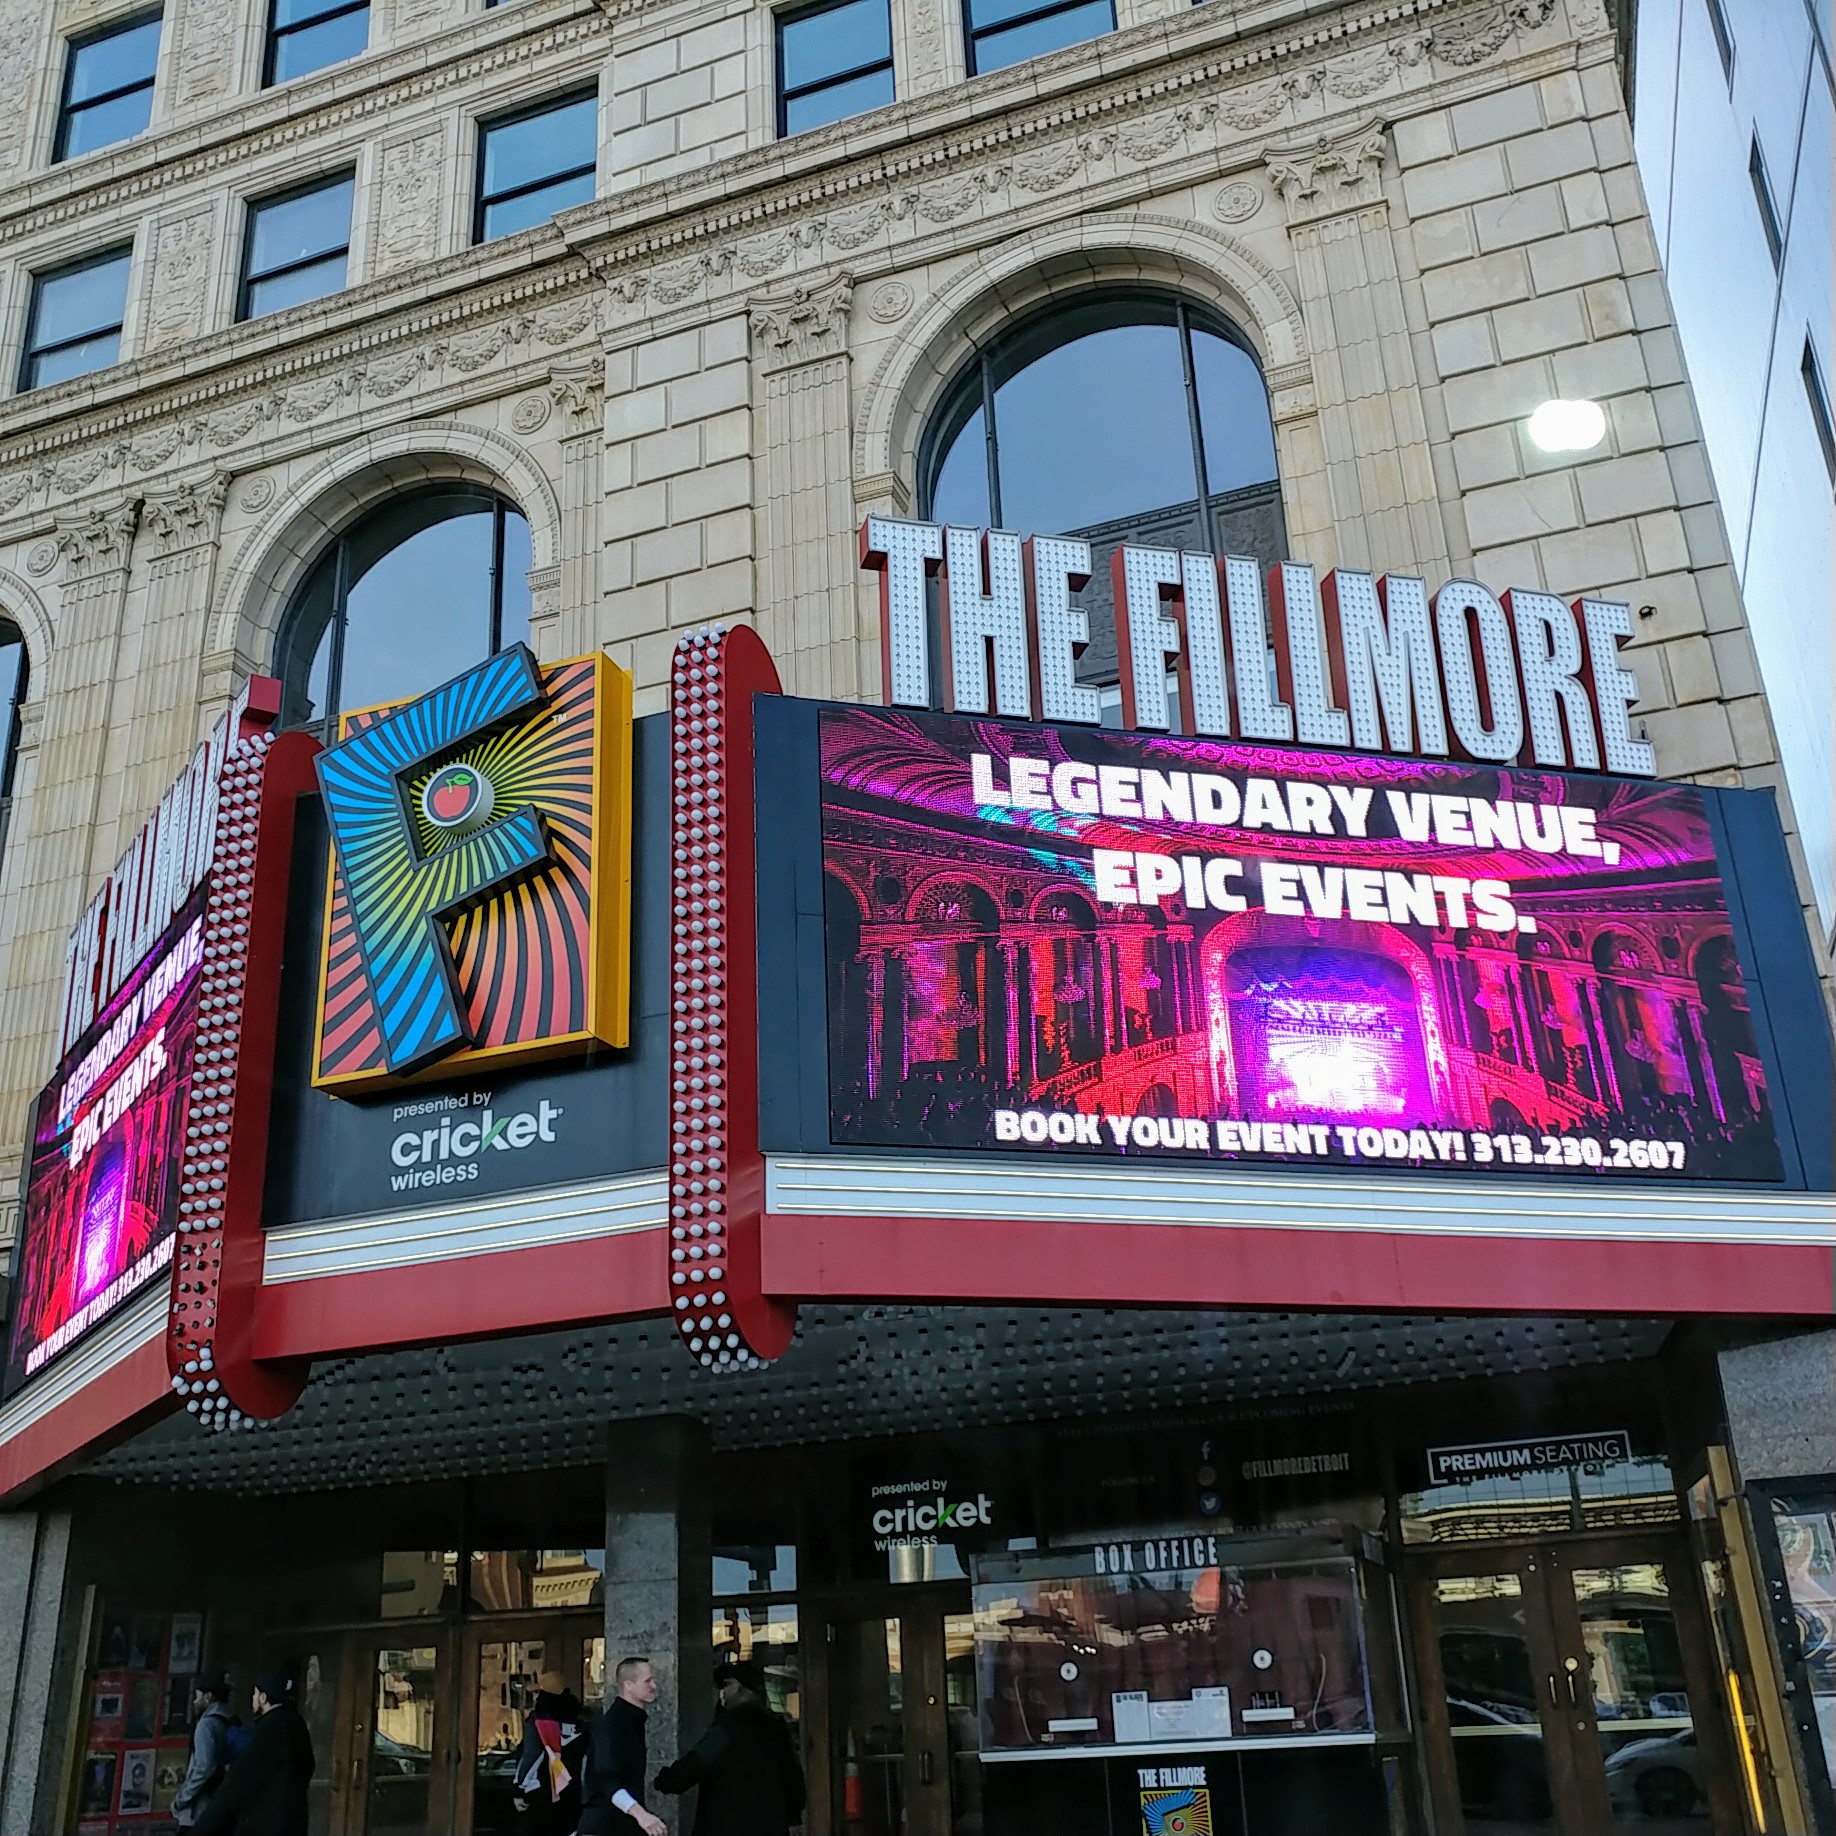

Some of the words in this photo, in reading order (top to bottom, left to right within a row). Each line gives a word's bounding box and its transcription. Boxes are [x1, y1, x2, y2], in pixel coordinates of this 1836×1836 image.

[861, 514, 1102, 724] THE
[1110, 543, 1658, 778] FILLMORE
[970, 754, 1375, 838] LEGENDARY
[1386, 789, 1620, 866] VENUE,
[1092, 848, 1251, 912] EPIC
[1260, 862, 1538, 934] EVENTS.
[58, 985, 143, 1125] LEGENDARY
[393, 1093, 469, 1122] presented
[472, 1091, 492, 1107] by
[69, 1098, 104, 1171] EPIC
[390, 1099, 560, 1167] cricket
[994, 1109, 1102, 1145] BOOK
[1105, 1114, 1211, 1150] YOUR
[1216, 1120, 1330, 1156] EVENT
[1342, 1126, 1468, 1162] TODAY!
[1470, 1132, 1686, 1170] 313.230.2607
[390, 1161, 480, 1192] wireless
[1439, 1449, 1531, 1473] PREMIUM
[1535, 1439, 1620, 1465] SEATING
[871, 1480, 929, 1498] presented
[932, 1478, 948, 1491] by
[872, 1493, 992, 1534] cricket
[874, 1534, 938, 1552] wireless
[1094, 1543, 1134, 1574] BOX
[1144, 1536, 1218, 1570] OFFICE
[1137, 1768, 1158, 1788] THE
[1159, 1766, 1207, 1787] FILLMORE
